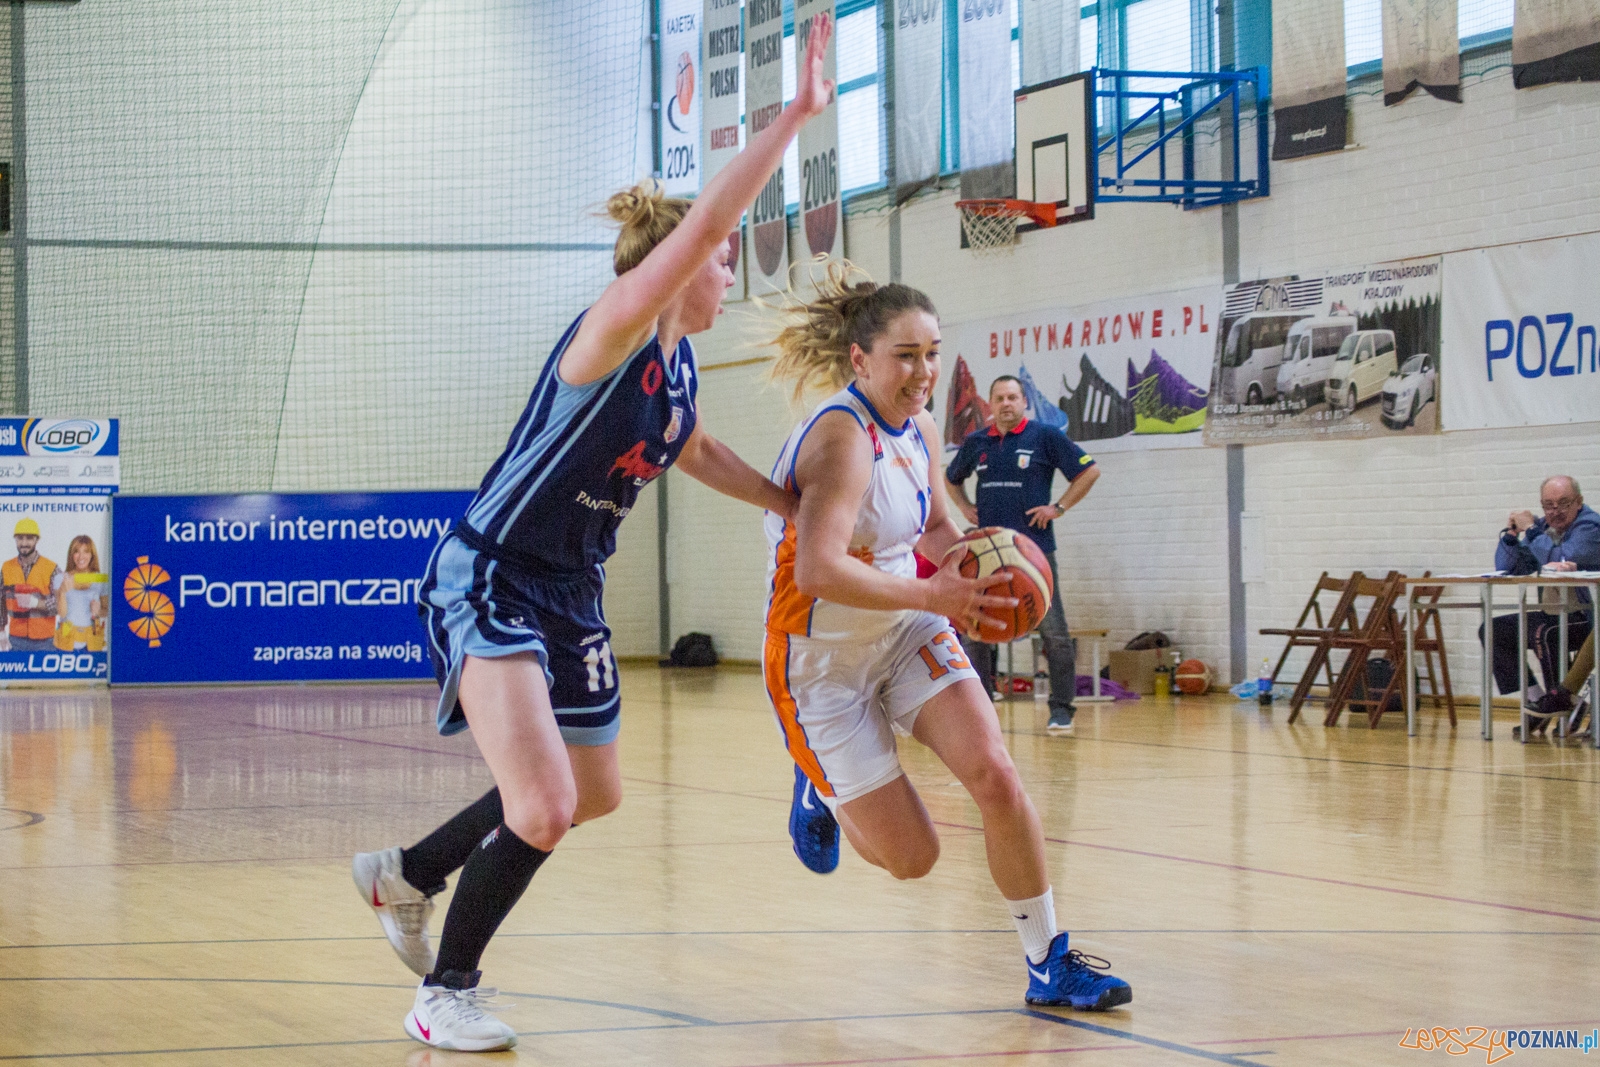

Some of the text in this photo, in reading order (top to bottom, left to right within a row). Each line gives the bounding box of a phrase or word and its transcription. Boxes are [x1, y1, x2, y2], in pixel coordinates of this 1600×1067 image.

[708, 24, 739, 59] MISTRZ
[750, 30, 782, 69] POLSKI
[710, 65, 739, 99] POLSKI
[710, 125, 738, 151] KADETEK
[803, 147, 837, 211] 2006
[1324, 271, 1366, 288] TRANSPORT
[1363, 285, 1405, 300] KRAJOWY
[1485, 312, 1600, 382] POZn
[35, 430, 92, 445] LOBO
[32, 502, 111, 512] INTERNETOWY
[165, 514, 451, 542] kantor internetowy
[0, 653, 107, 677] www.LOBO.p
[253, 645, 333, 664] zaprasza
[338, 647, 362, 660] na
[366, 641, 422, 663] swoją
[583, 641, 615, 692] 11
[918, 631, 972, 682] 13
